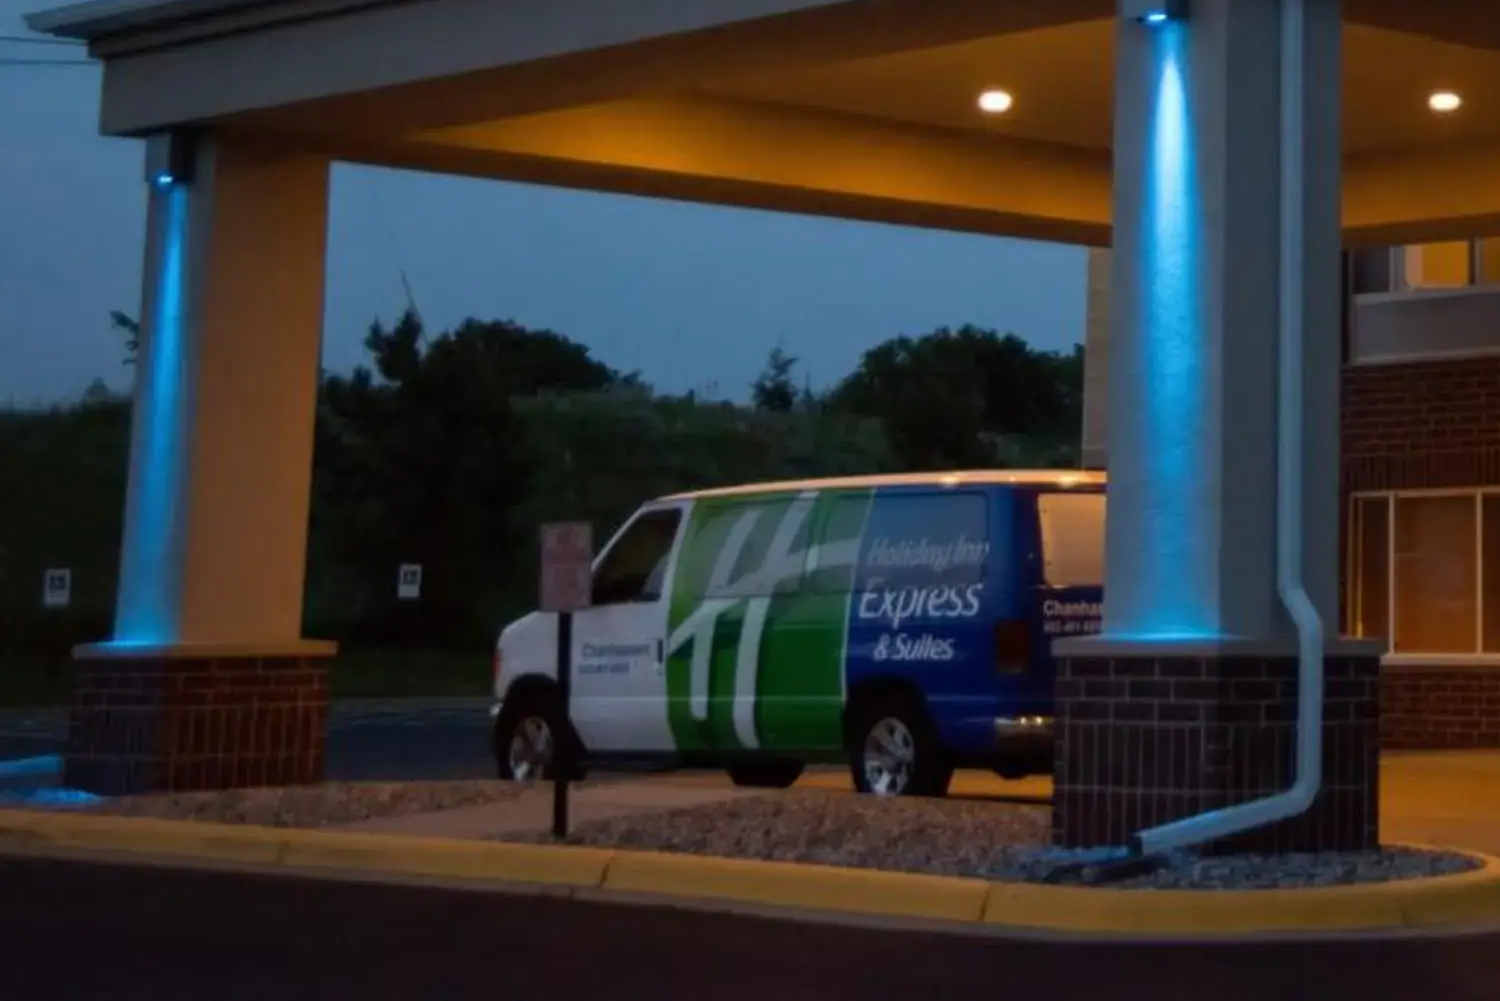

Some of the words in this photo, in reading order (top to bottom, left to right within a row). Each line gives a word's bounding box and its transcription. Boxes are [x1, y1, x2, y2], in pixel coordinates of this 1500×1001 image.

[866, 536, 952, 573] Holiday
[950, 533, 991, 565] Inn
[858, 576, 985, 631] Express
[872, 631, 891, 663] &
[890, 631, 957, 662] Suites
